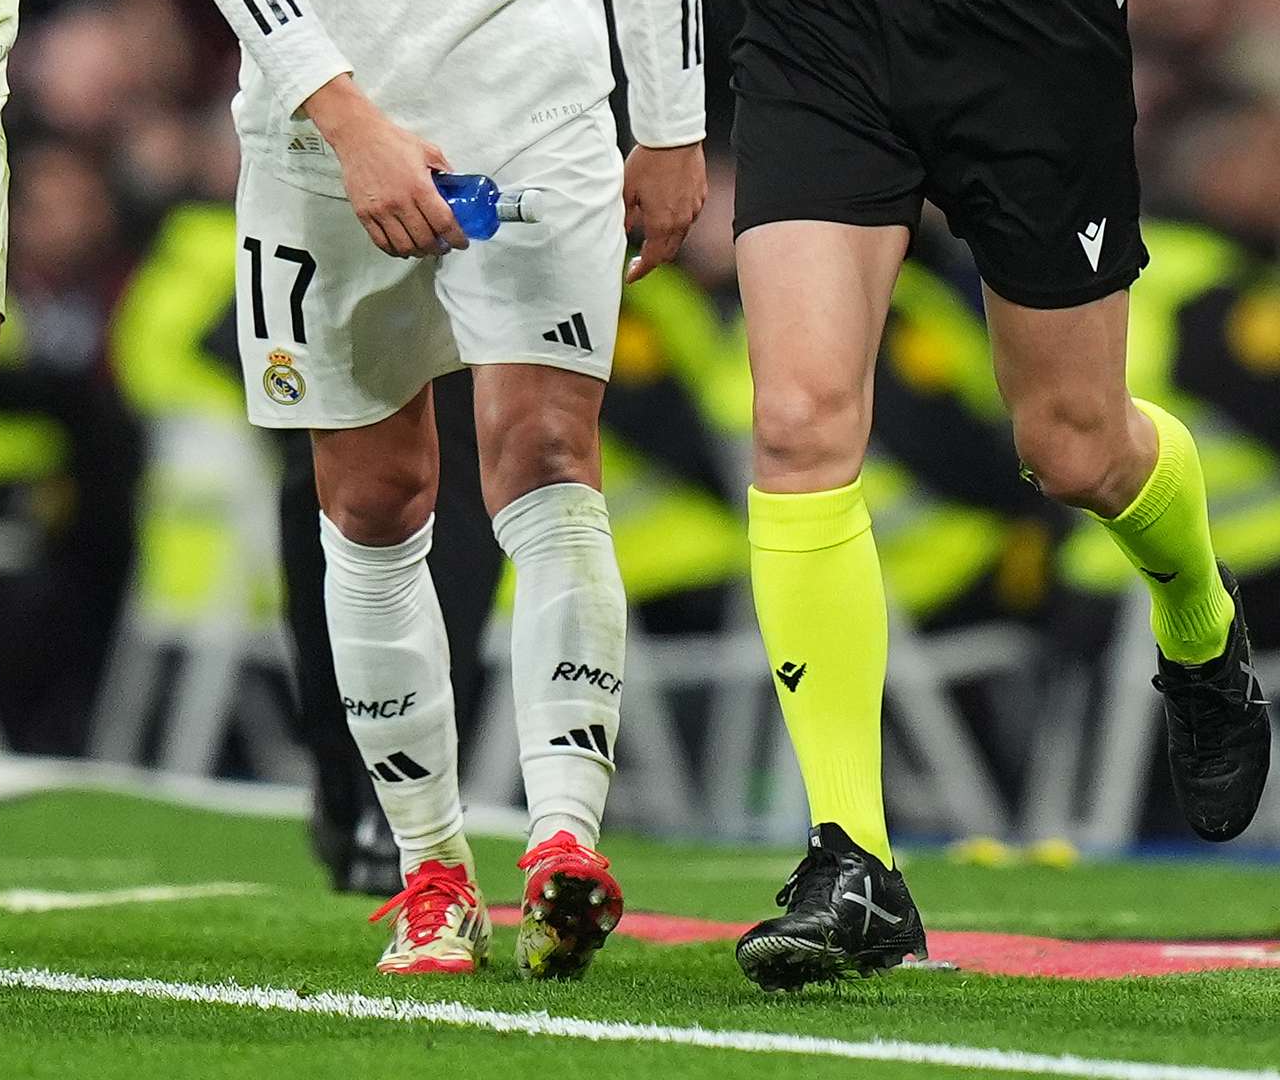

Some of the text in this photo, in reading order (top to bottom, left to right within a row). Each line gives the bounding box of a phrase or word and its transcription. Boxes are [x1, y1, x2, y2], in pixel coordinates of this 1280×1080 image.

[243, 236, 317, 345] 17
[551, 661, 623, 695] RMCF
[343, 691, 417, 719] RMCF
